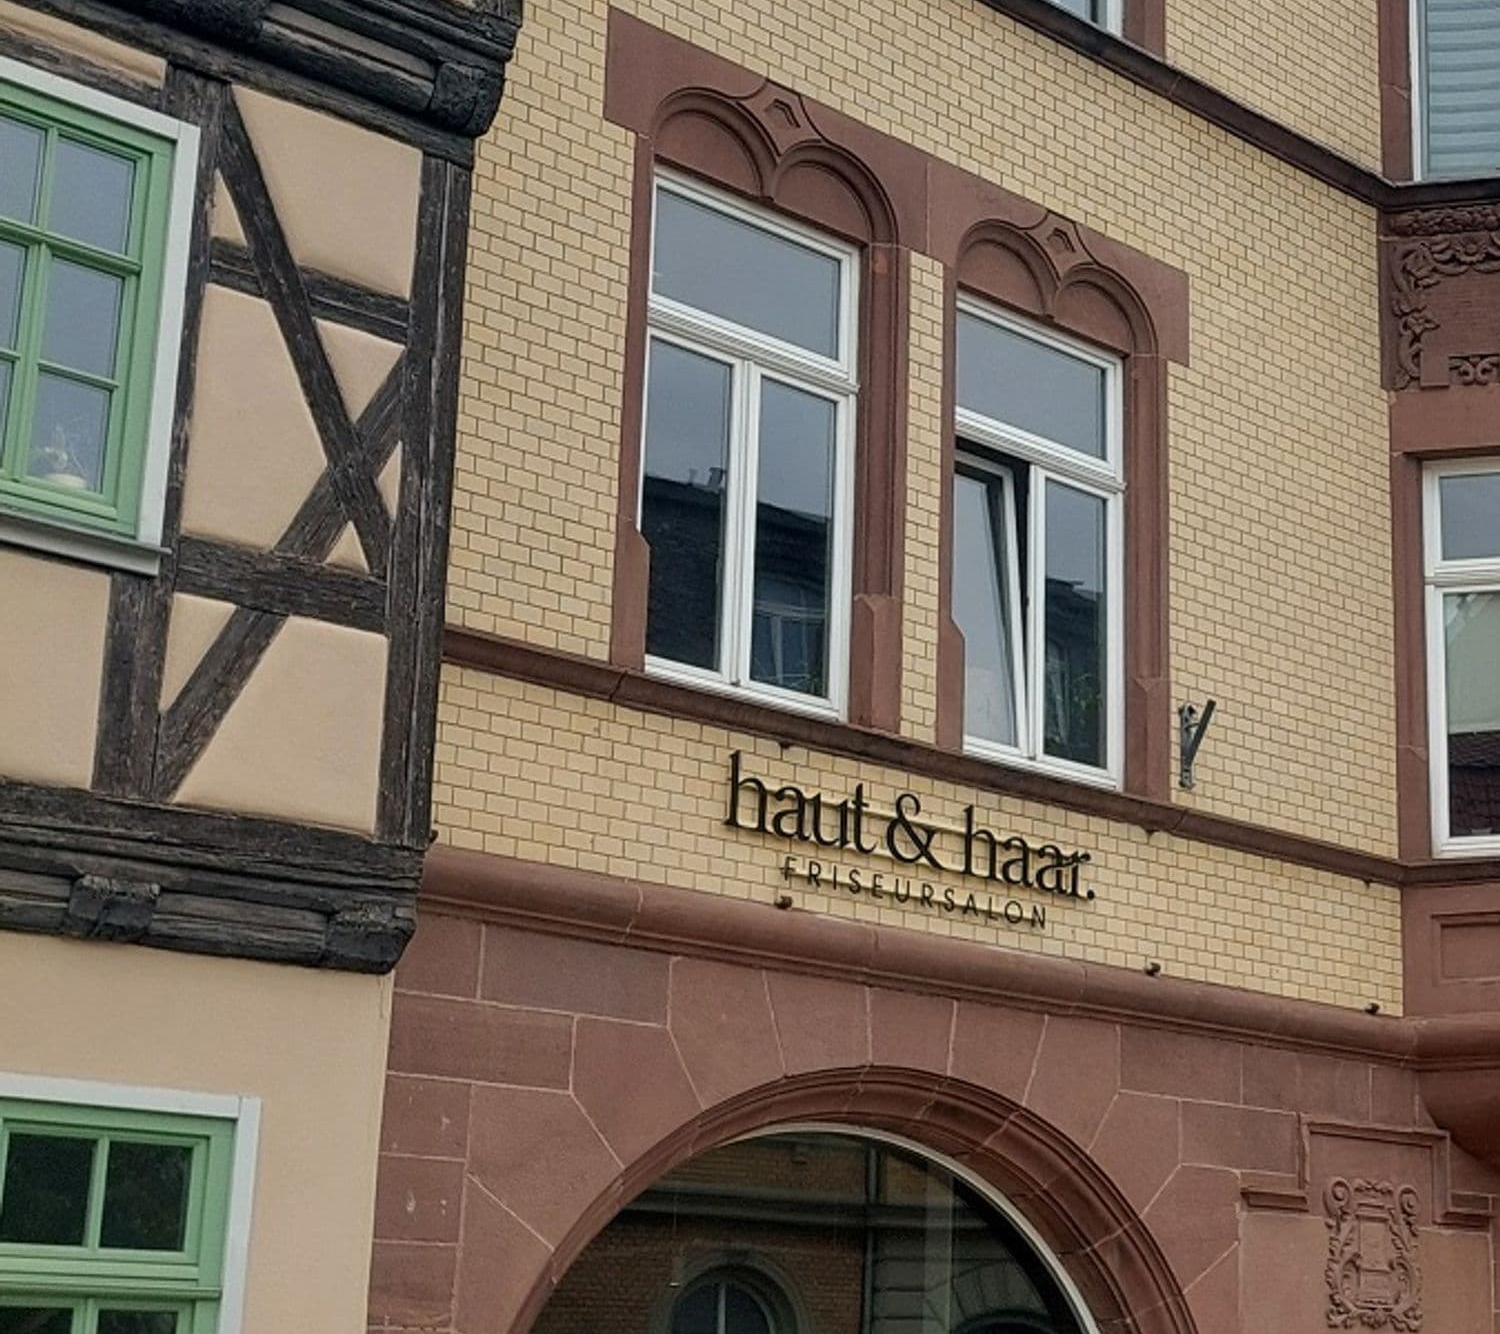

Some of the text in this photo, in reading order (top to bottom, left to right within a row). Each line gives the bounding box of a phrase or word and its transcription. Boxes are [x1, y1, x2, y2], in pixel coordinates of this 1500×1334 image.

[725, 750, 1096, 900] haut & haar.
[780, 855, 1048, 929] FRISEURSALON
